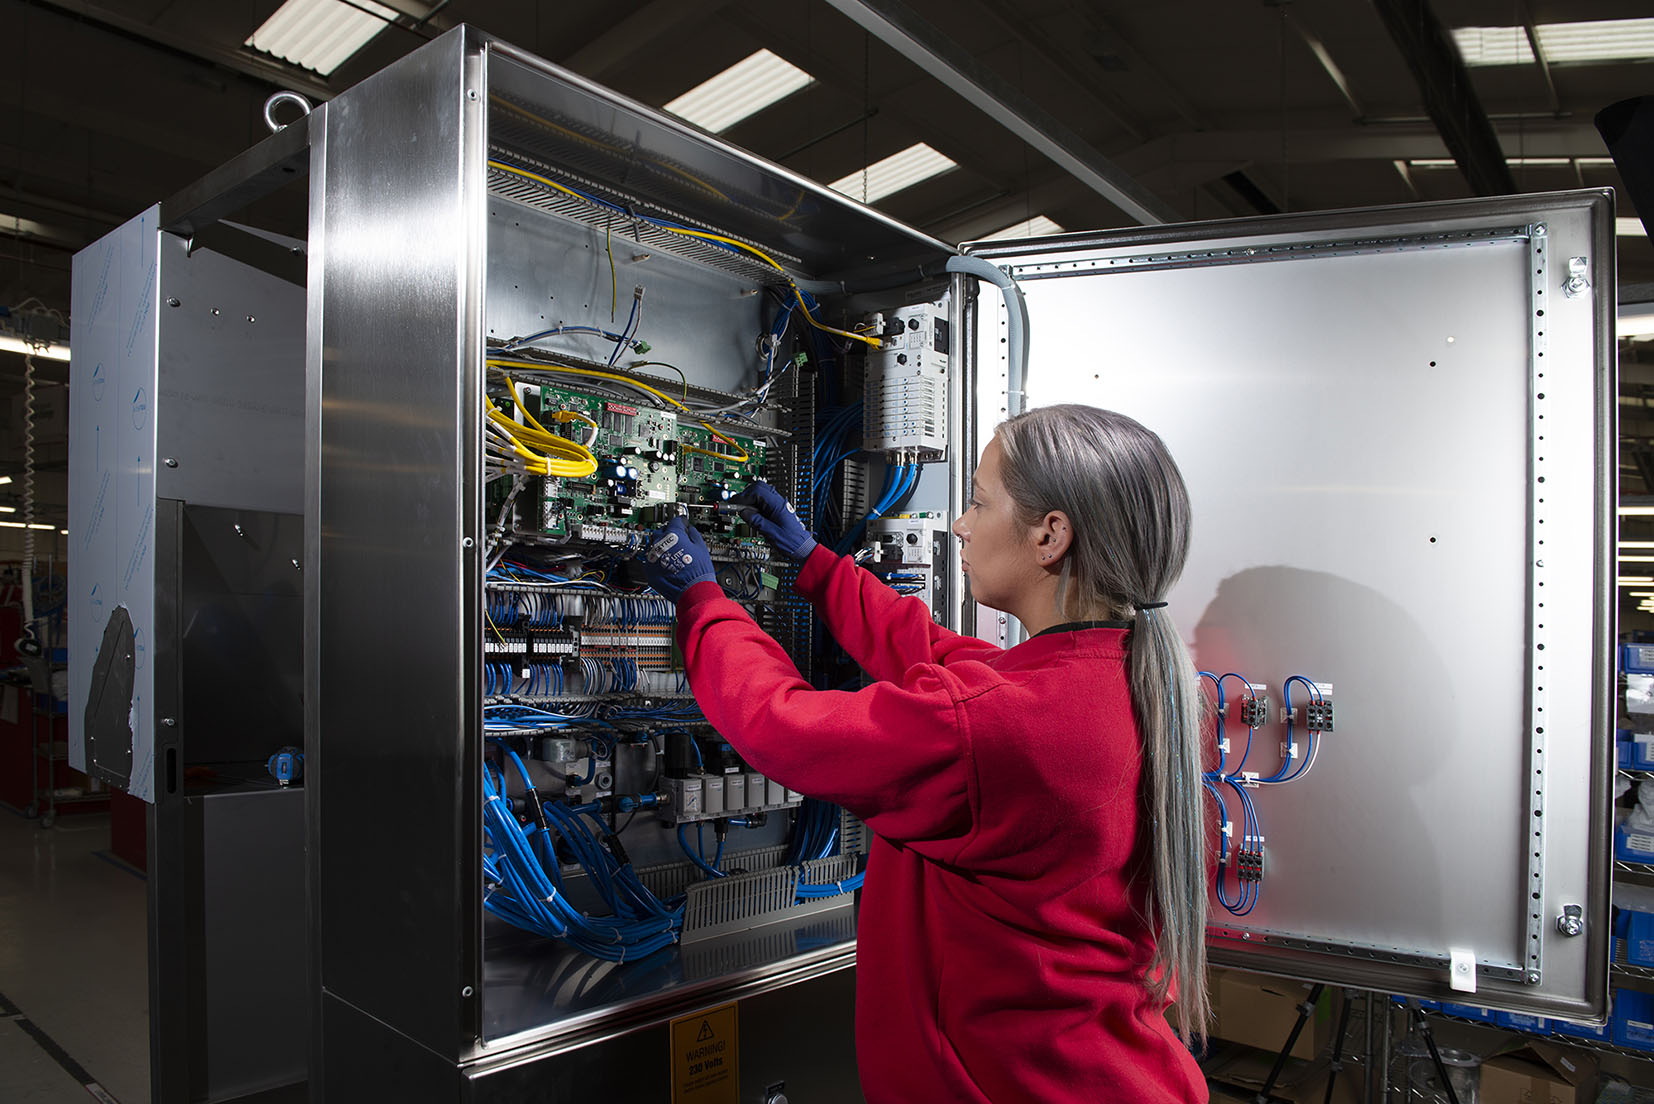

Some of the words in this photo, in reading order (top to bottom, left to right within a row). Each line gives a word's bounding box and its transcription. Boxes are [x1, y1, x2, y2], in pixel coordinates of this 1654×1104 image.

[686, 1040, 726, 1062] WARNING!
[688, 1063, 703, 1075] 230
[704, 1056, 723, 1070] Volts
